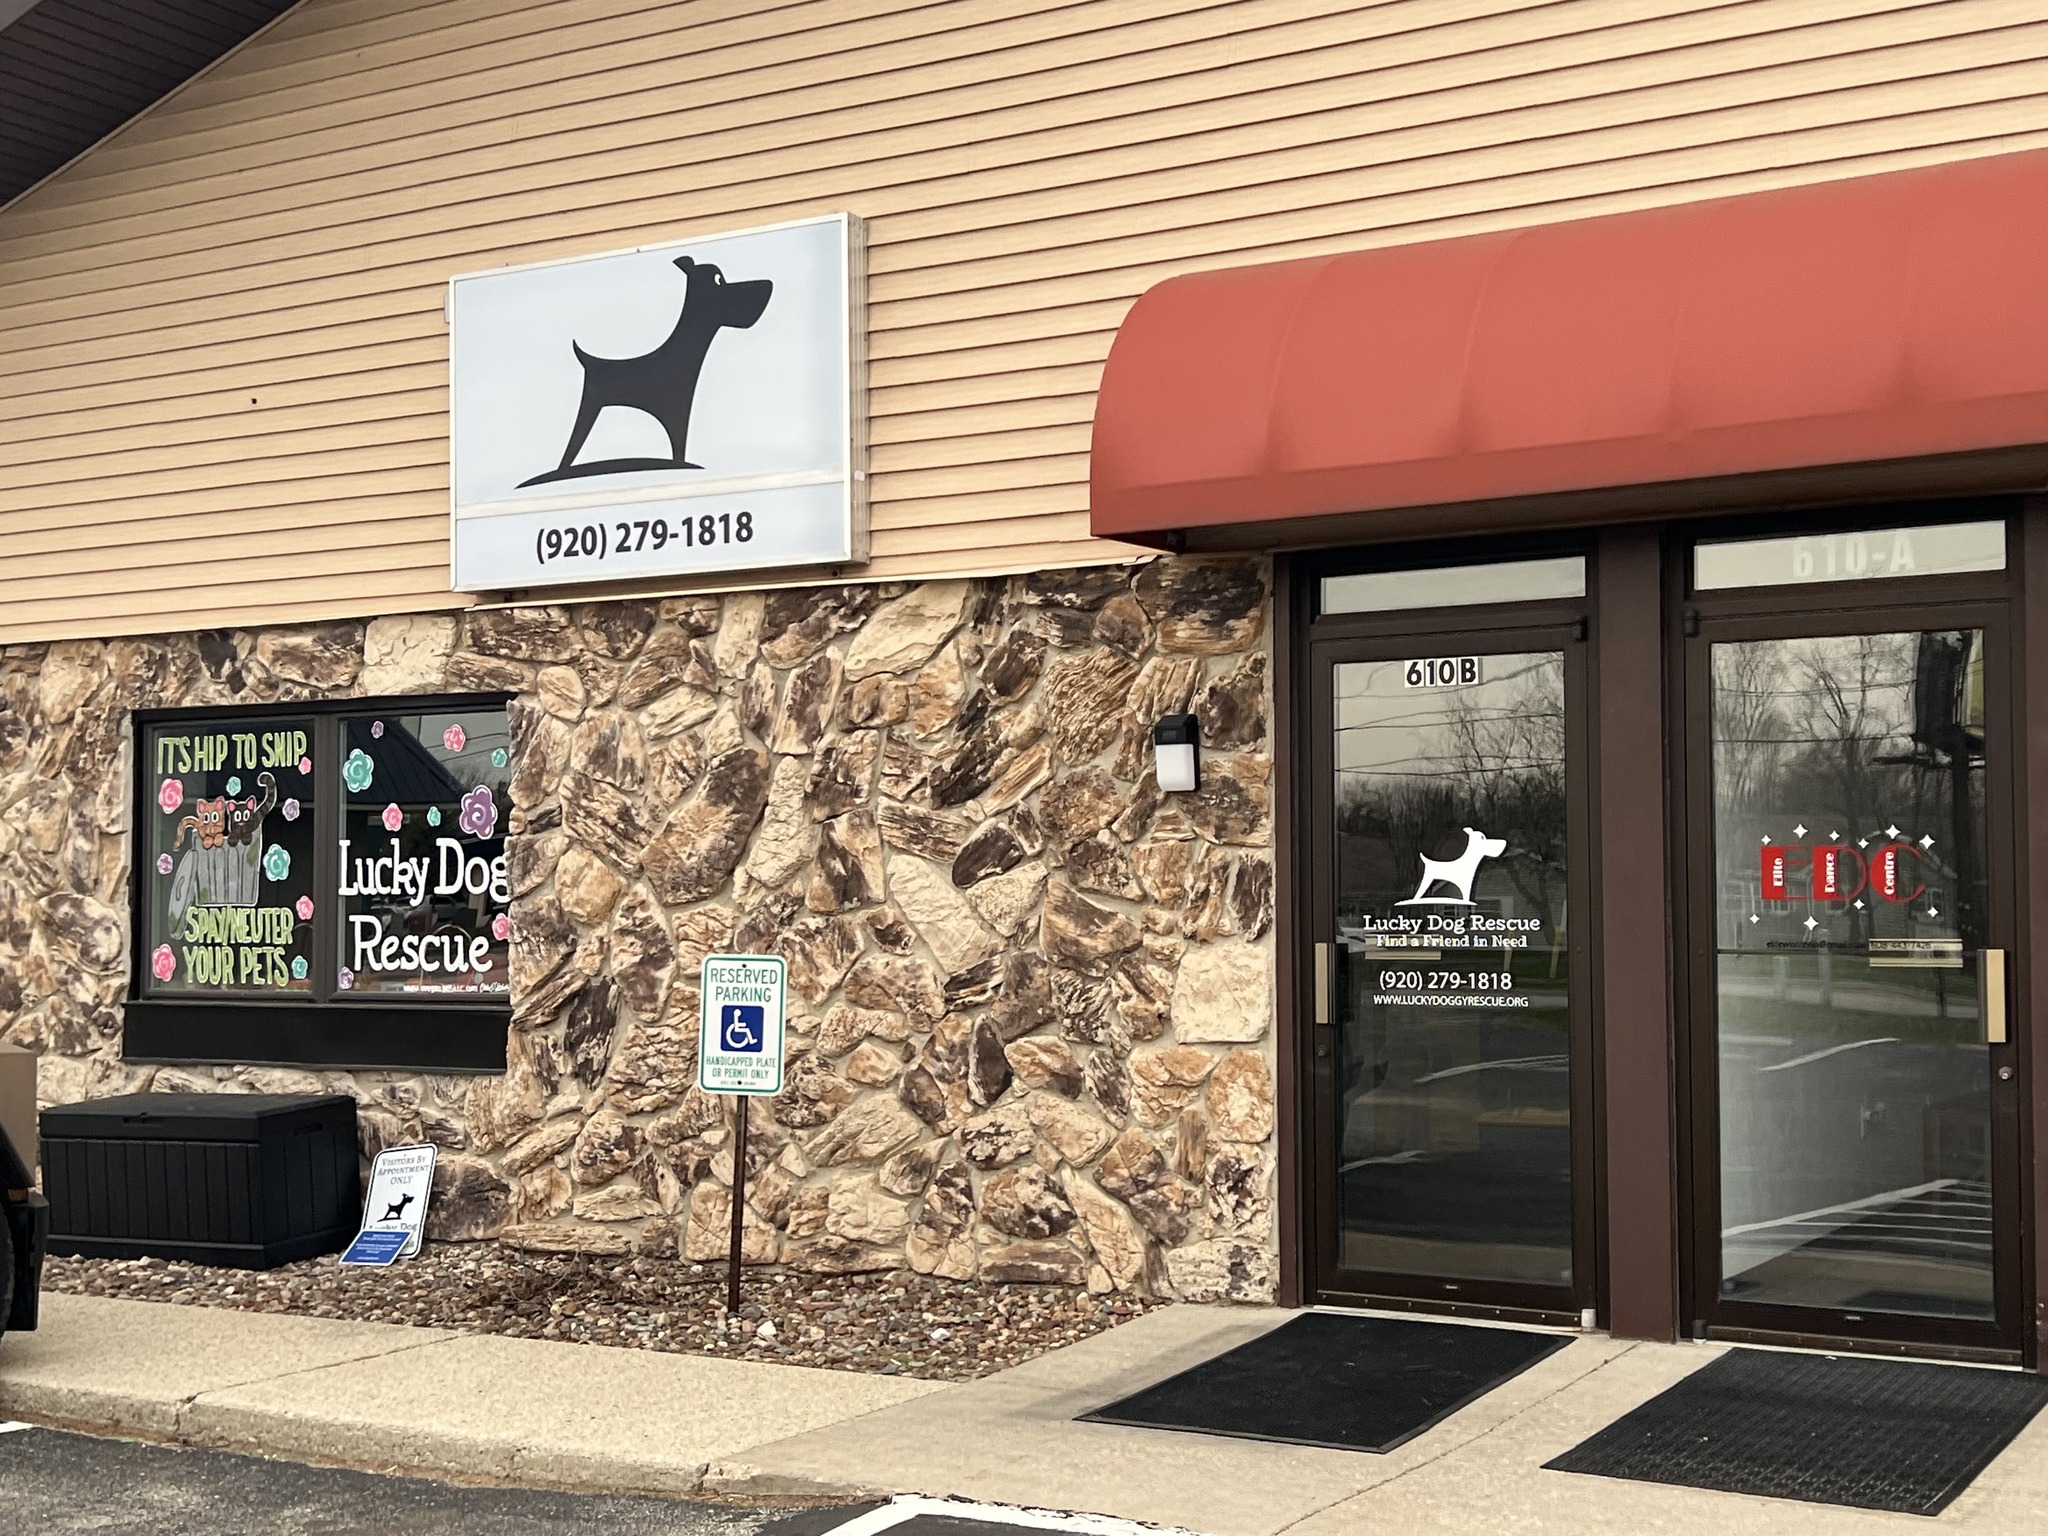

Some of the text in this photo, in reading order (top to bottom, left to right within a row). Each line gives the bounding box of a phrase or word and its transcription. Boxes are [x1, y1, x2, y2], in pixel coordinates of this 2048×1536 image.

[536, 511, 754, 564] (920) 279-1818
[1793, 532, 1916, 578] 610-A
[1406, 658, 1477, 685] 610B
[194, 734, 228, 772] HIP
[232, 733, 257, 769] TO
[261, 731, 307, 768] SNIP
[338, 837, 511, 907] Lucky Dog
[1760, 843, 1926, 902] EDC
[1824, 852, 1836, 893] Dance
[1883, 851, 1895, 895] Centre
[1362, 915, 1540, 934] Lucky Dog Rescue
[349, 914, 493, 973] Rescue
[1376, 935, 1528, 948] Find a Friend in Need
[182, 946, 289, 987] YOUR PETS
[710, 968, 778, 984] RESERVED
[1379, 970, 1513, 991] (920) 279-1818
[715, 986, 772, 1002] PARKING
[1373, 994, 1529, 1007] WWW.LUCKYDOGGYRESCUE.ORG
[706, 1056, 776, 1068] HANDICAPPED PLATE
[712, 1067, 769, 1079] OR PERMIT ONLY
[377, 1165, 430, 1176] APPOINTMENT
[390, 1176, 413, 1185] ONLY
